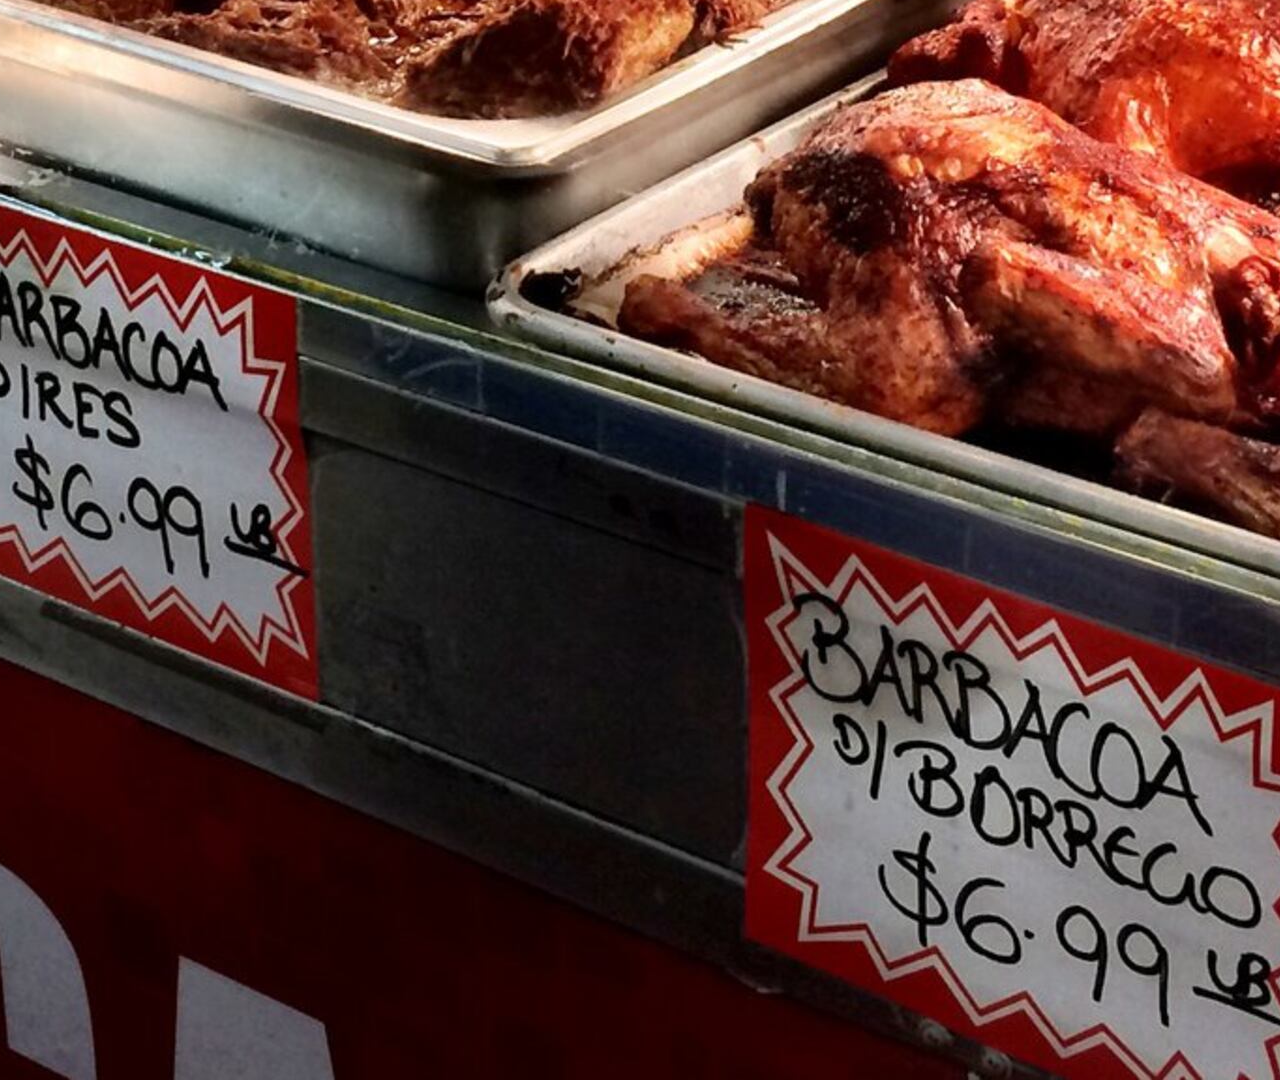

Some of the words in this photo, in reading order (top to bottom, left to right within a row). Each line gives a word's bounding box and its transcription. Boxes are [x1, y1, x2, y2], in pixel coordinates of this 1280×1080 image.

[12, 434, 209, 579] $6.99
[794, 591, 1213, 837] BARBACOA
[879, 831, 1169, 1027] $6.99
